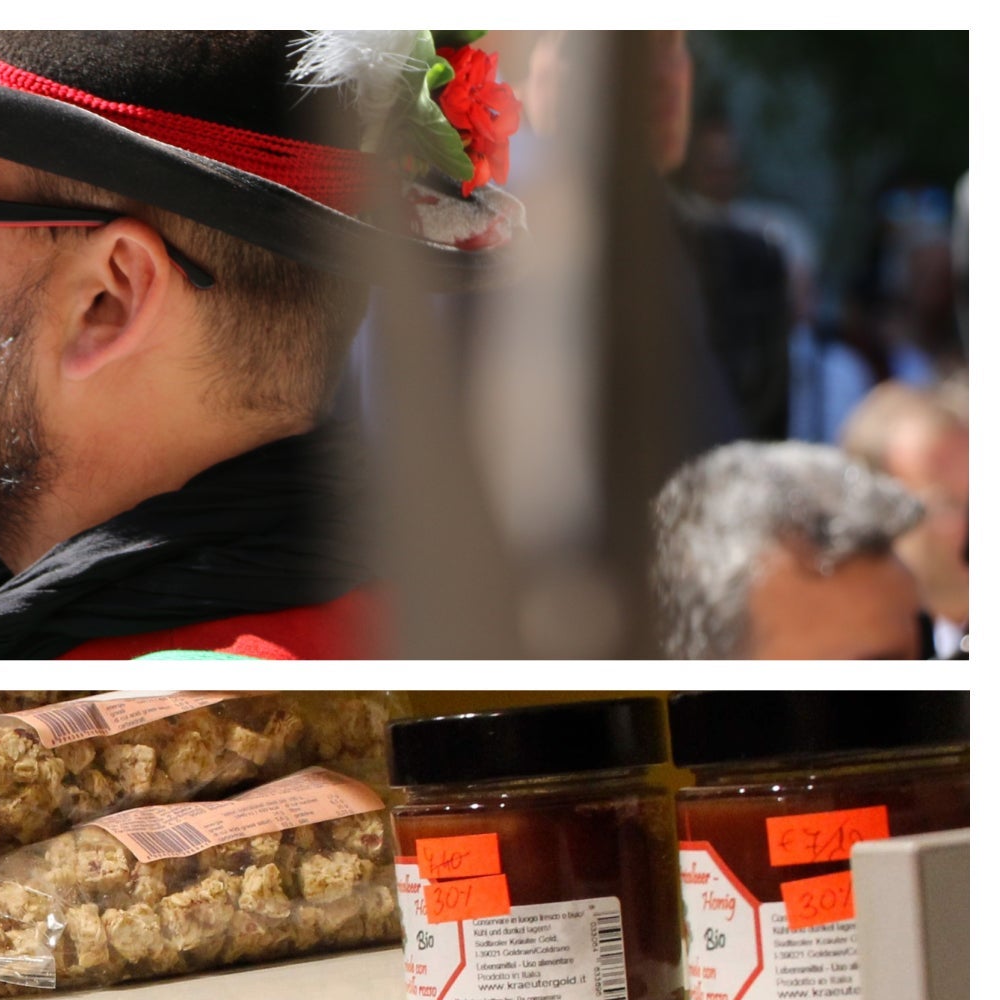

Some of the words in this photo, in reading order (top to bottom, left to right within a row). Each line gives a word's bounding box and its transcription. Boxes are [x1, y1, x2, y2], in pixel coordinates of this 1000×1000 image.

[702, 892, 736, 921] Honig
[416, 930, 435, 950] Bio
[704, 927, 726, 951] Bio
[477, 972, 510, 981] Prodotto
